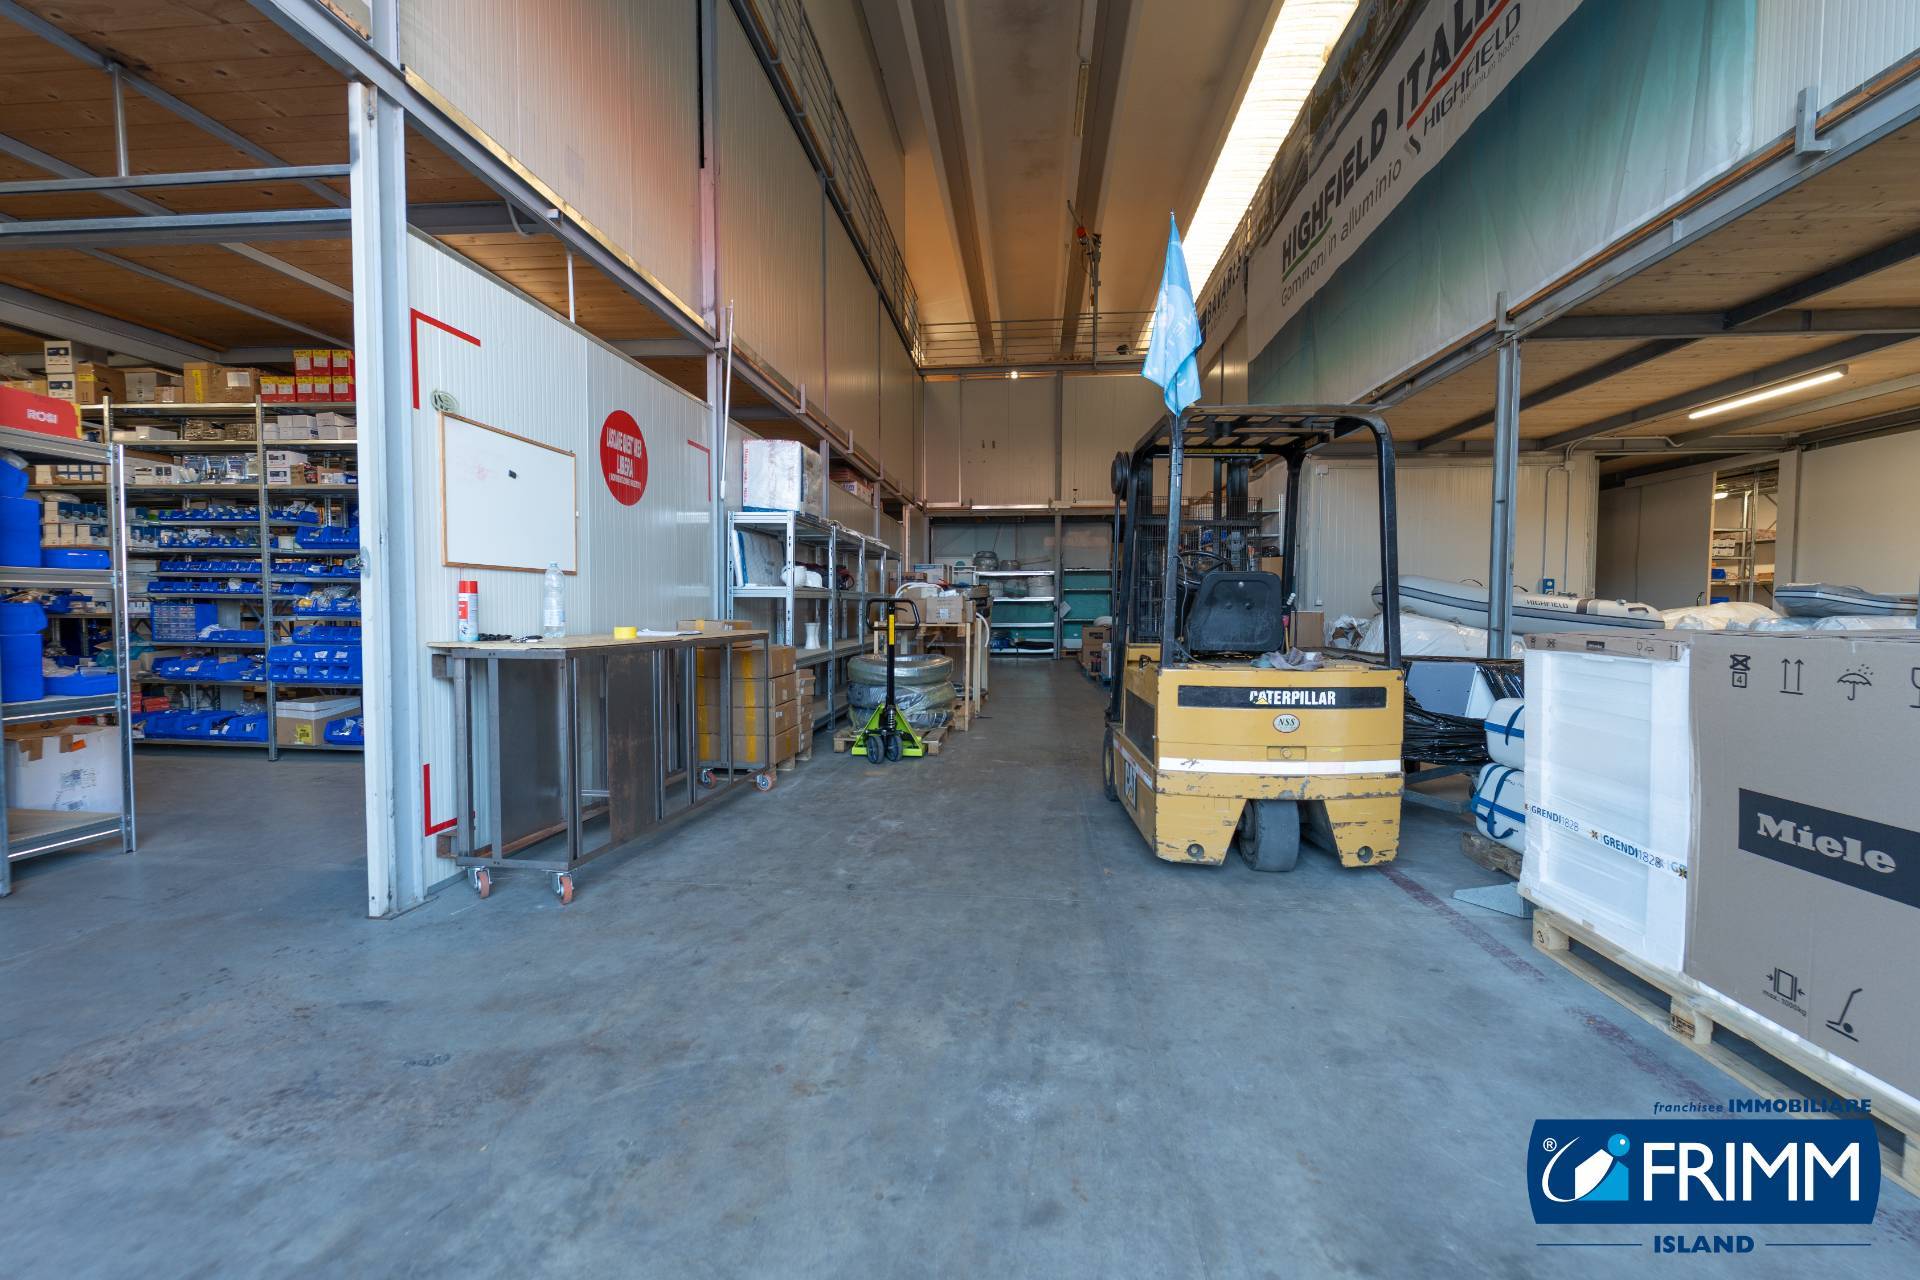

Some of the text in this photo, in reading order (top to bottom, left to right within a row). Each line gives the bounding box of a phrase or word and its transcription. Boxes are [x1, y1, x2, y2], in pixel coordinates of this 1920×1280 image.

[1423, 3, 1520, 136] HIGHFIELD
[1282, 0, 1496, 272] HIGHFIELD ITALI
[1281, 158, 1402, 307] Gommoni in alluminio
[1249, 689, 1336, 706] CATERPILLAR
[1279, 717, 1296, 727] NSS
[1757, 812, 1897, 874] Miele
